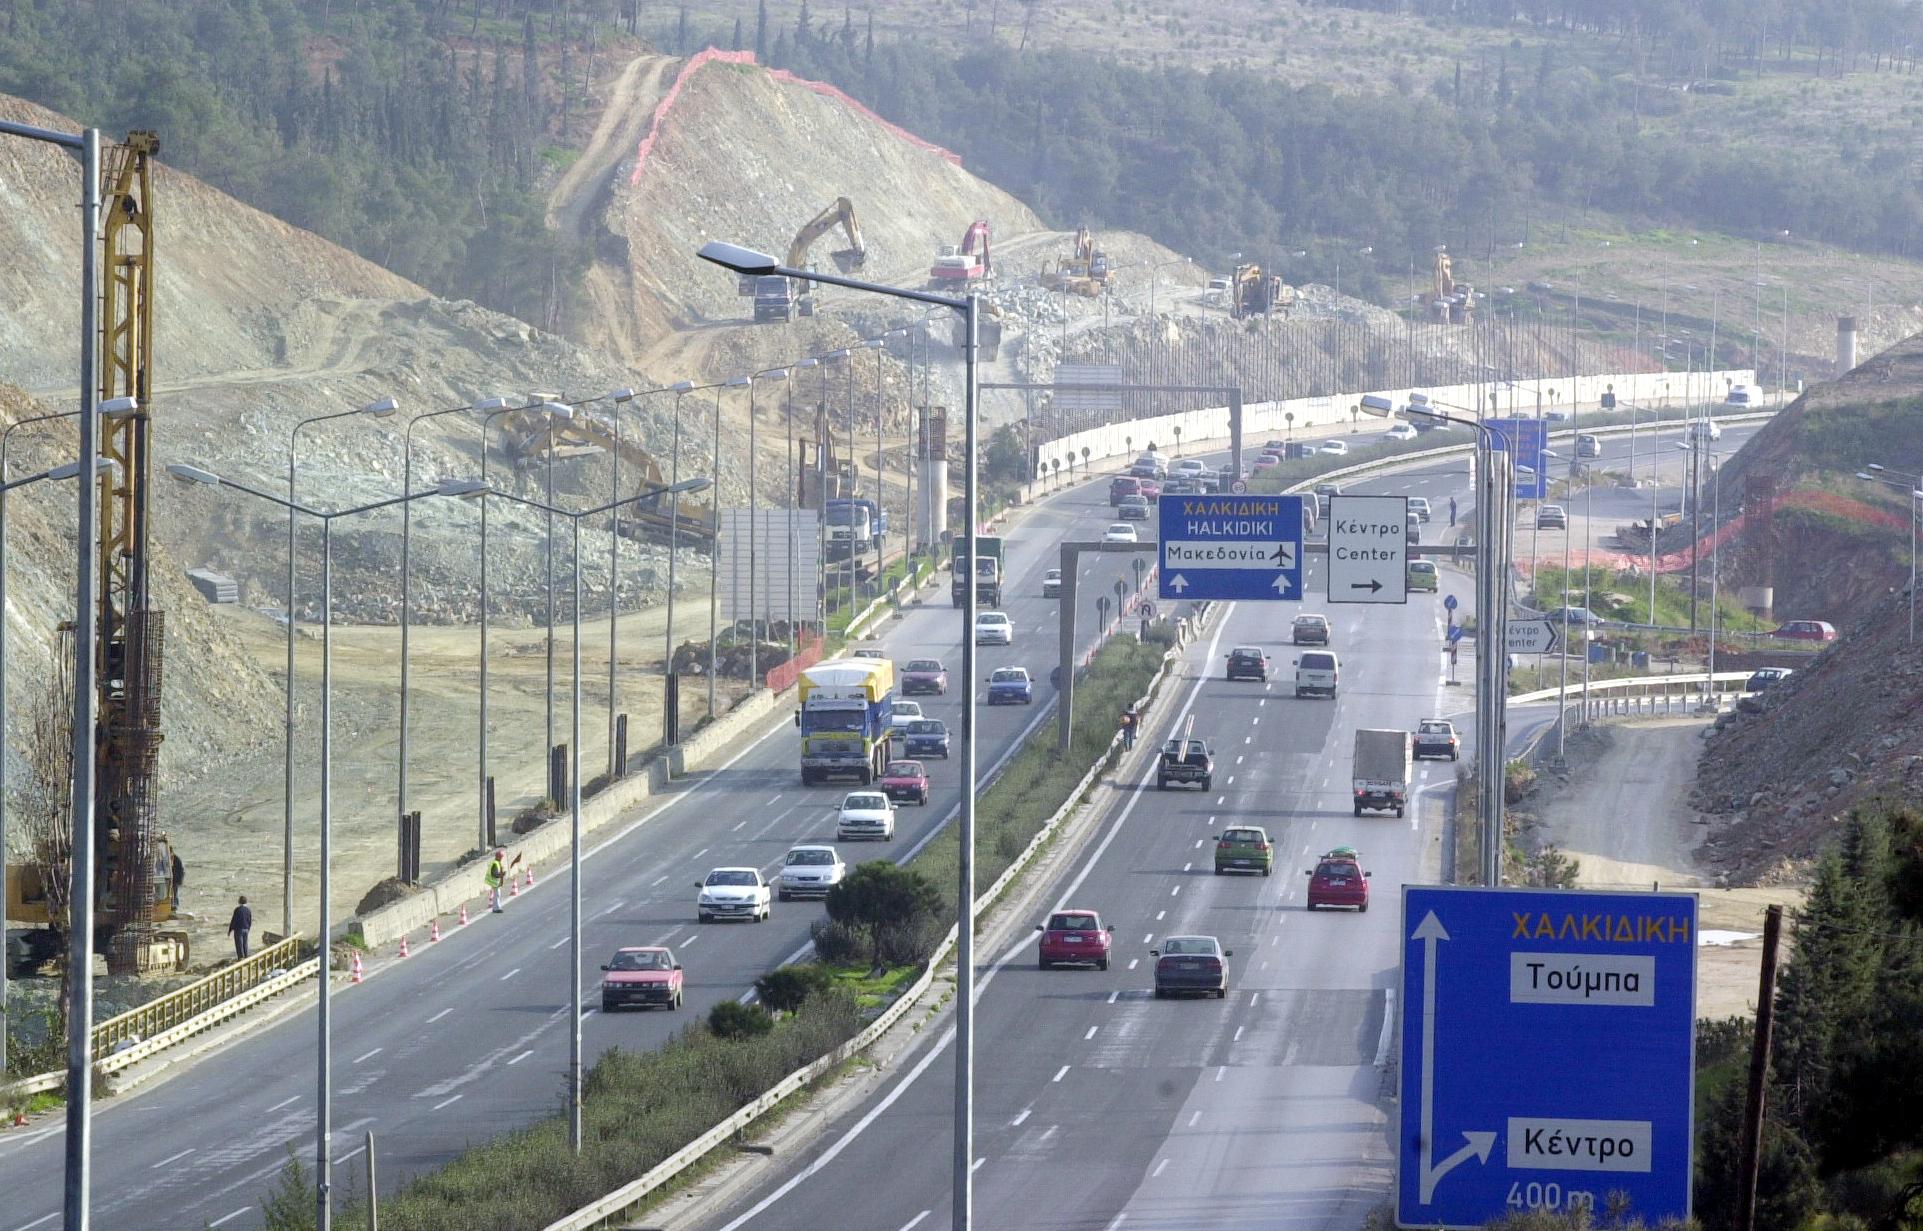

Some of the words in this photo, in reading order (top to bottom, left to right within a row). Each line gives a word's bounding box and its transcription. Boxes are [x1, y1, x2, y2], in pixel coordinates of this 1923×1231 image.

[1183, 501, 1279, 516] ΧΑΛΚΙΔΙΚΗ
[1187, 521, 1273, 535] HALKIDIKI
[1336, 519, 1399, 538] Κέντρο
[1167, 545, 1266, 561] Μακεδονία
[1336, 547, 1397, 561] Center
[1511, 912, 1690, 943] ΧΑΛΚΙΔΙΚΗ
[1526, 963, 1640, 998] Τούμπα
[1524, 1128, 1634, 1163] Κέντρο
[1506, 1181, 1561, 1210] 400
[1567, 1190, 1594, 1212] m
